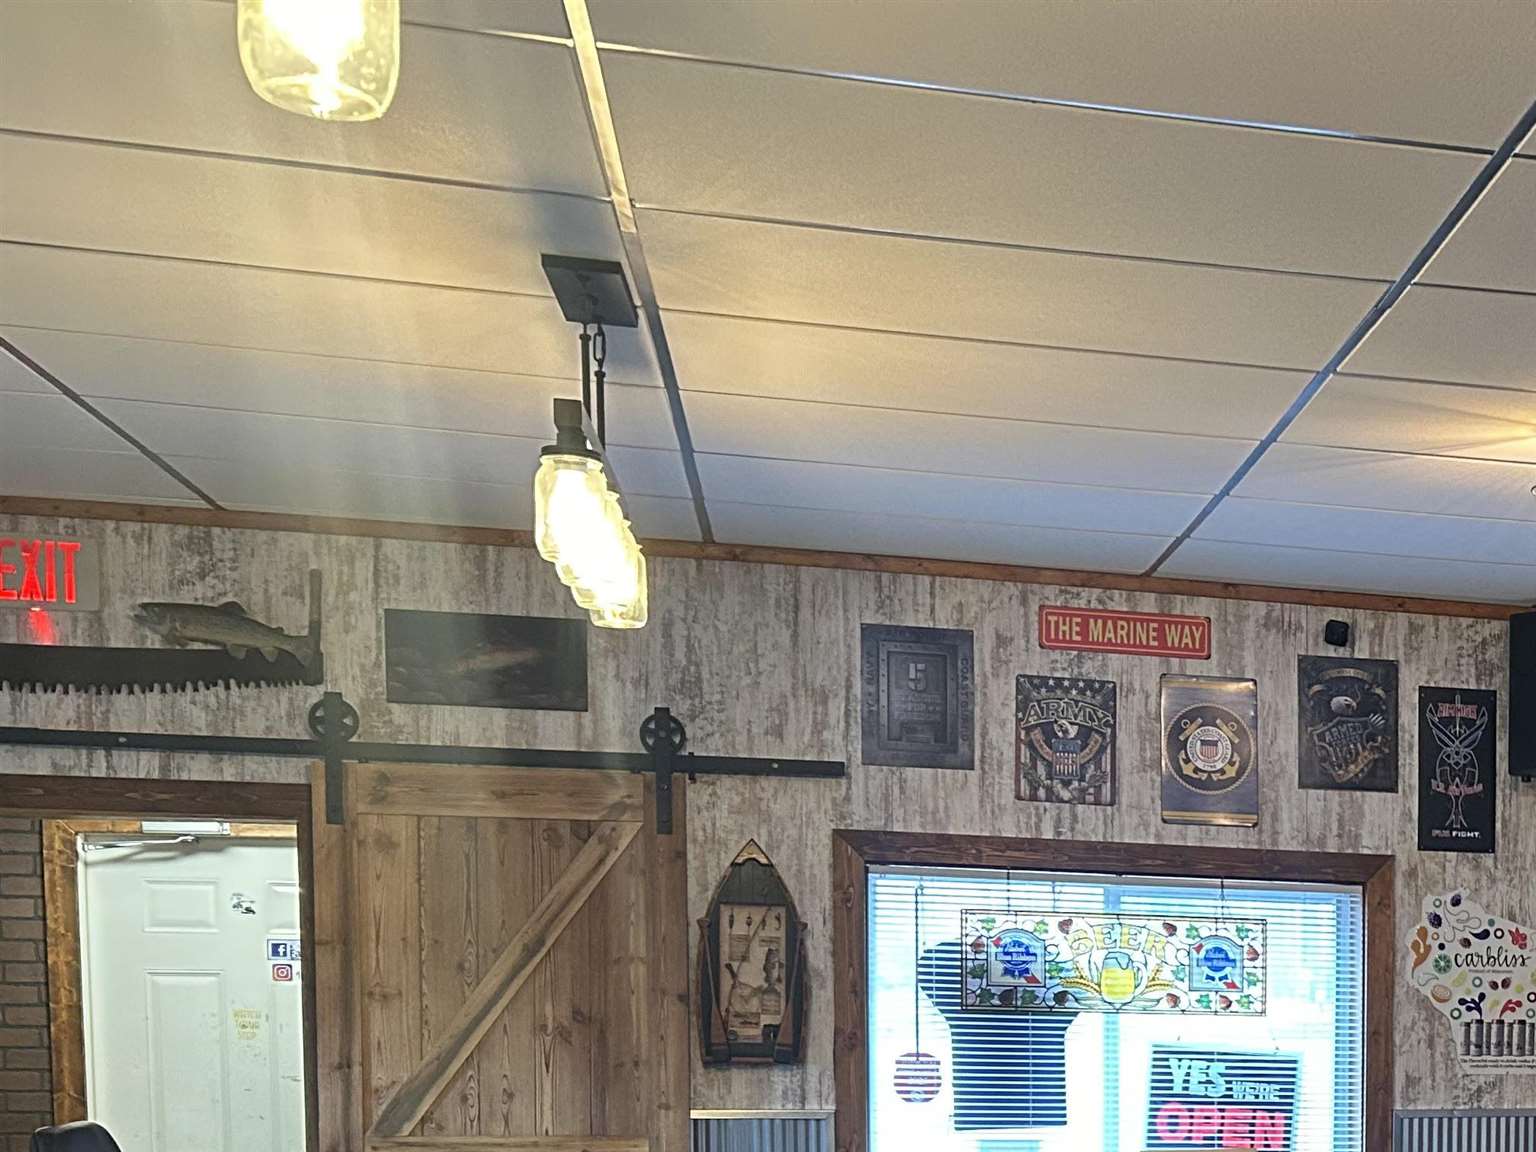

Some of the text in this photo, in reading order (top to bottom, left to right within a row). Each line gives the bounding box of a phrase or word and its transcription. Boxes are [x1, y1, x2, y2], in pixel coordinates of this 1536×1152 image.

[0, 538, 81, 604] EXIT
[1047, 615, 1203, 649] THE MARINE WAY
[1021, 699, 1115, 733] ARMY
[1066, 924, 1168, 959] BEER
[1454, 945, 1532, 969] carbliss
[1168, 1058, 1227, 1098] YES
[1157, 1101, 1285, 1149] OPEN
